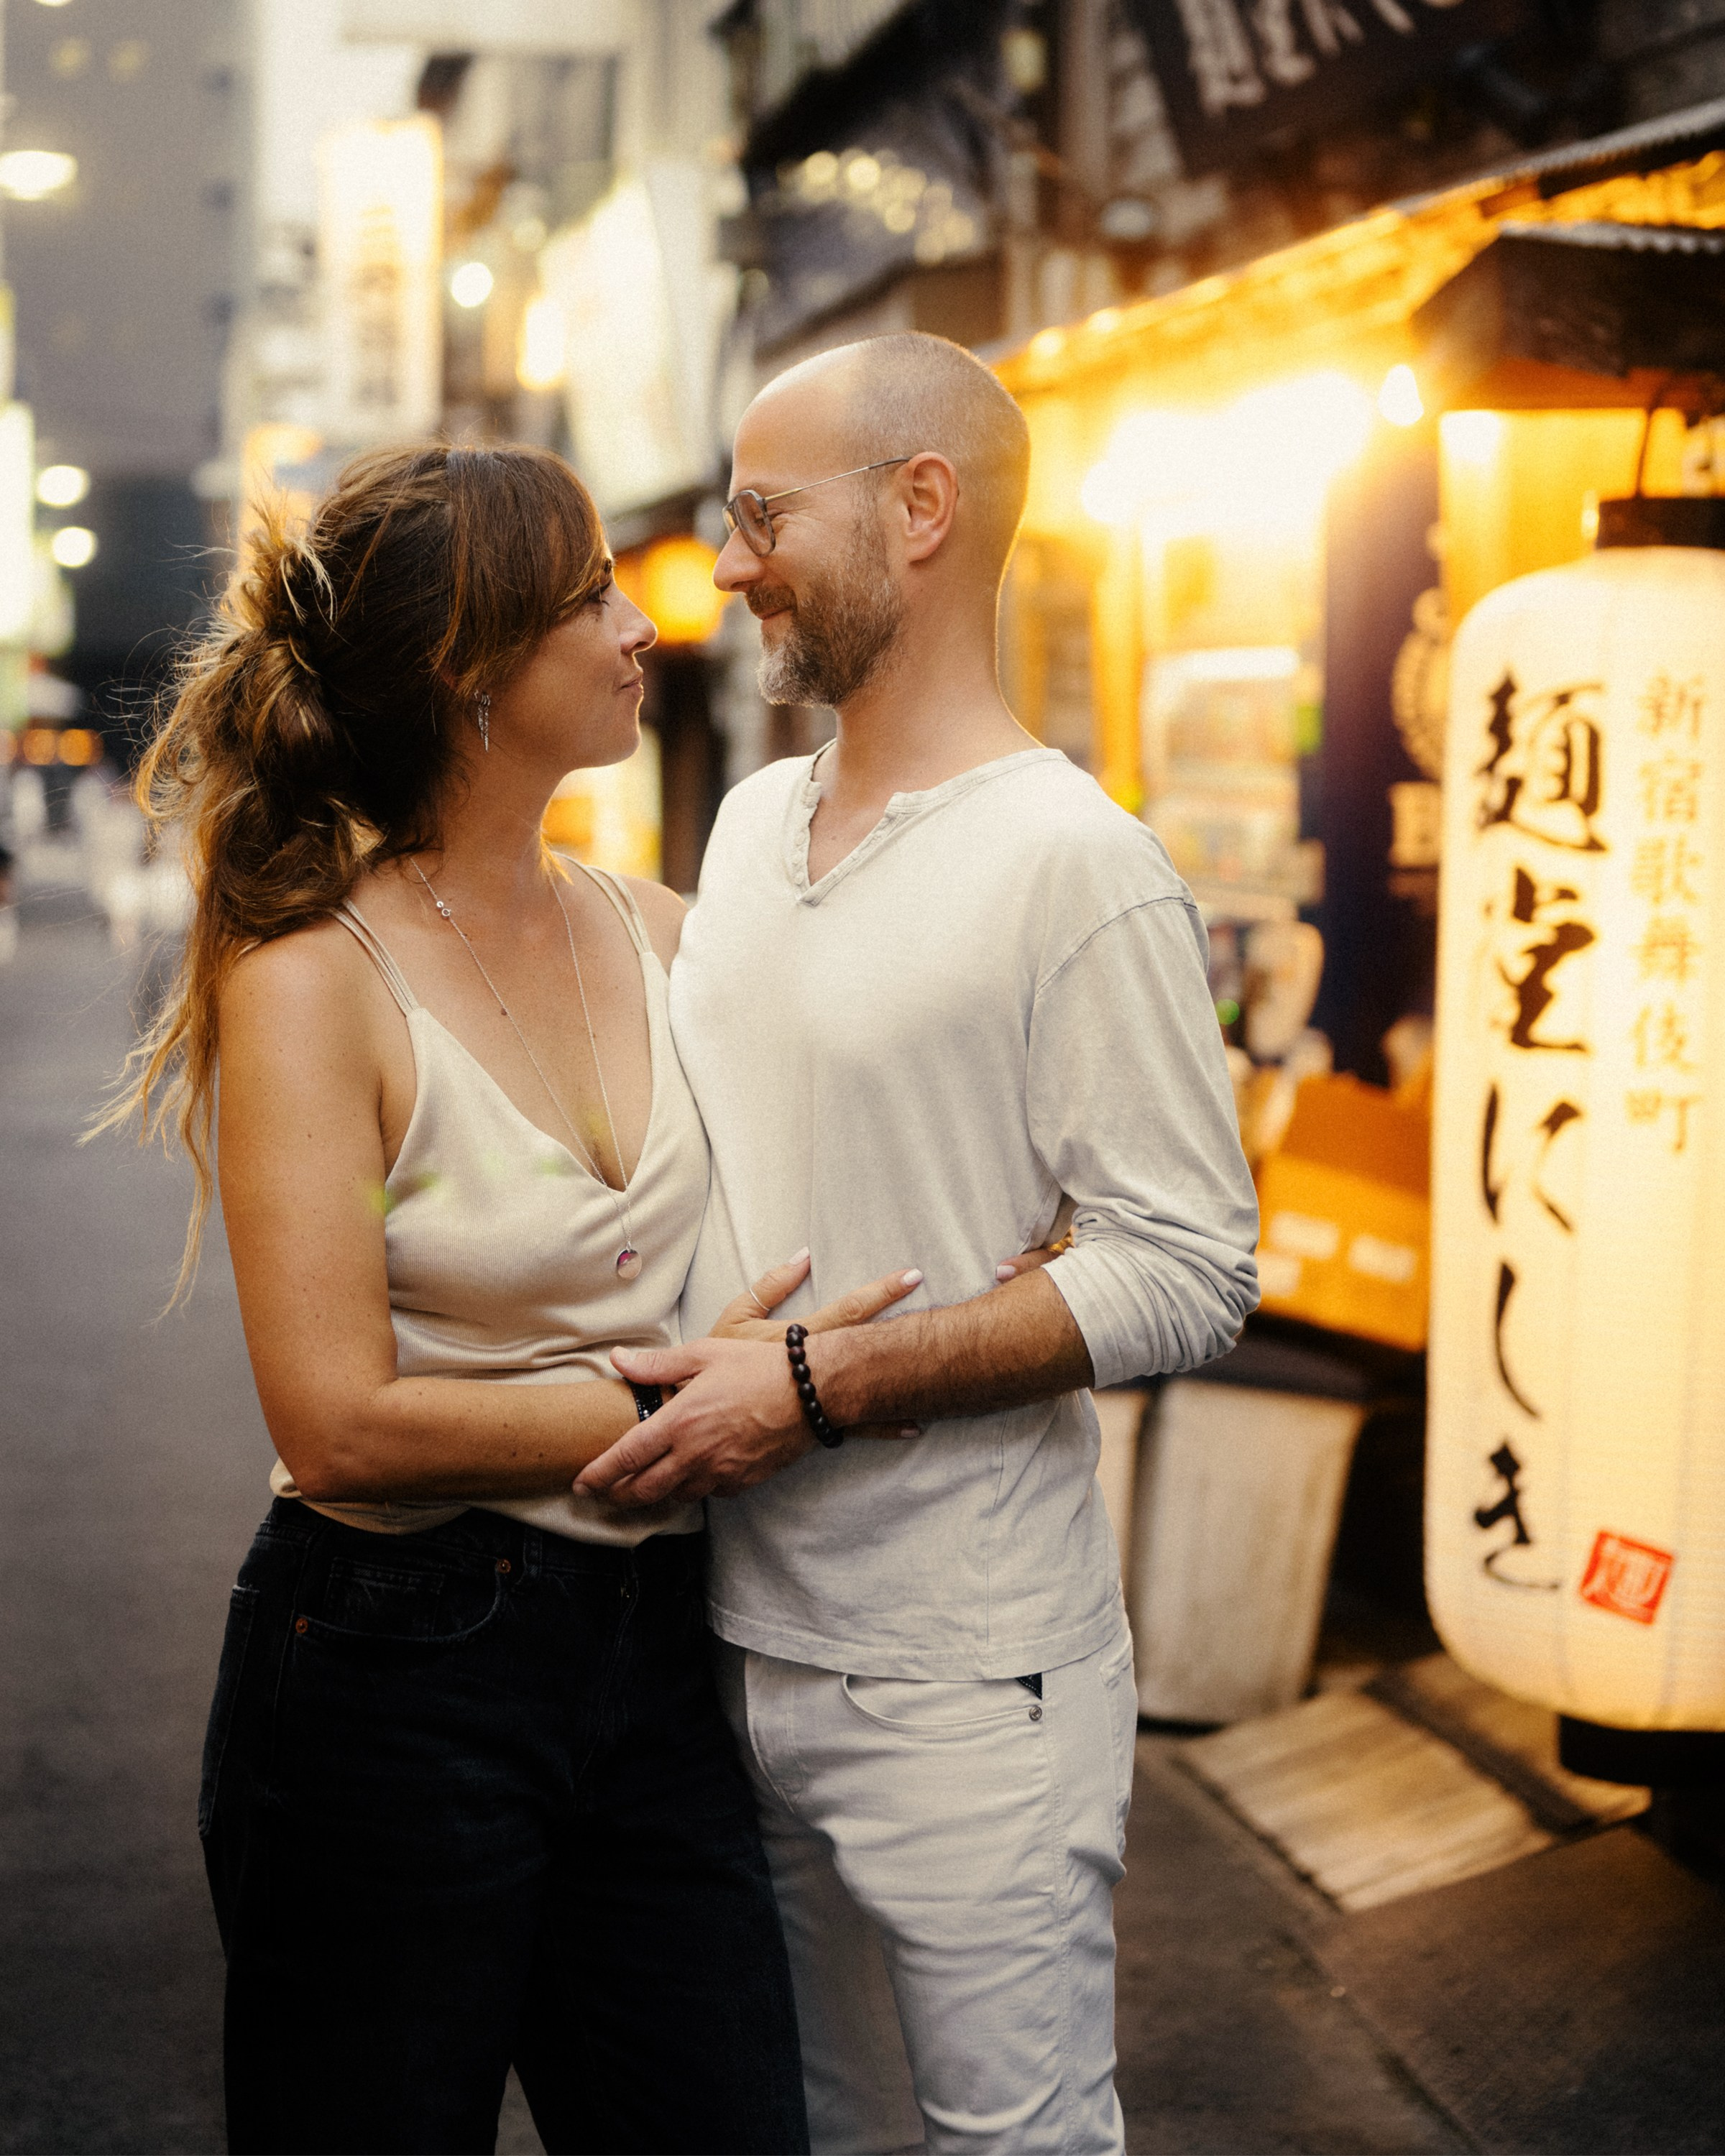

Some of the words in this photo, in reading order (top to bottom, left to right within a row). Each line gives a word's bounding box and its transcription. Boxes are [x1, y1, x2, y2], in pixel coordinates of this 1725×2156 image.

[1626, 672, 1706, 1154] 新宿歌舞伎町
